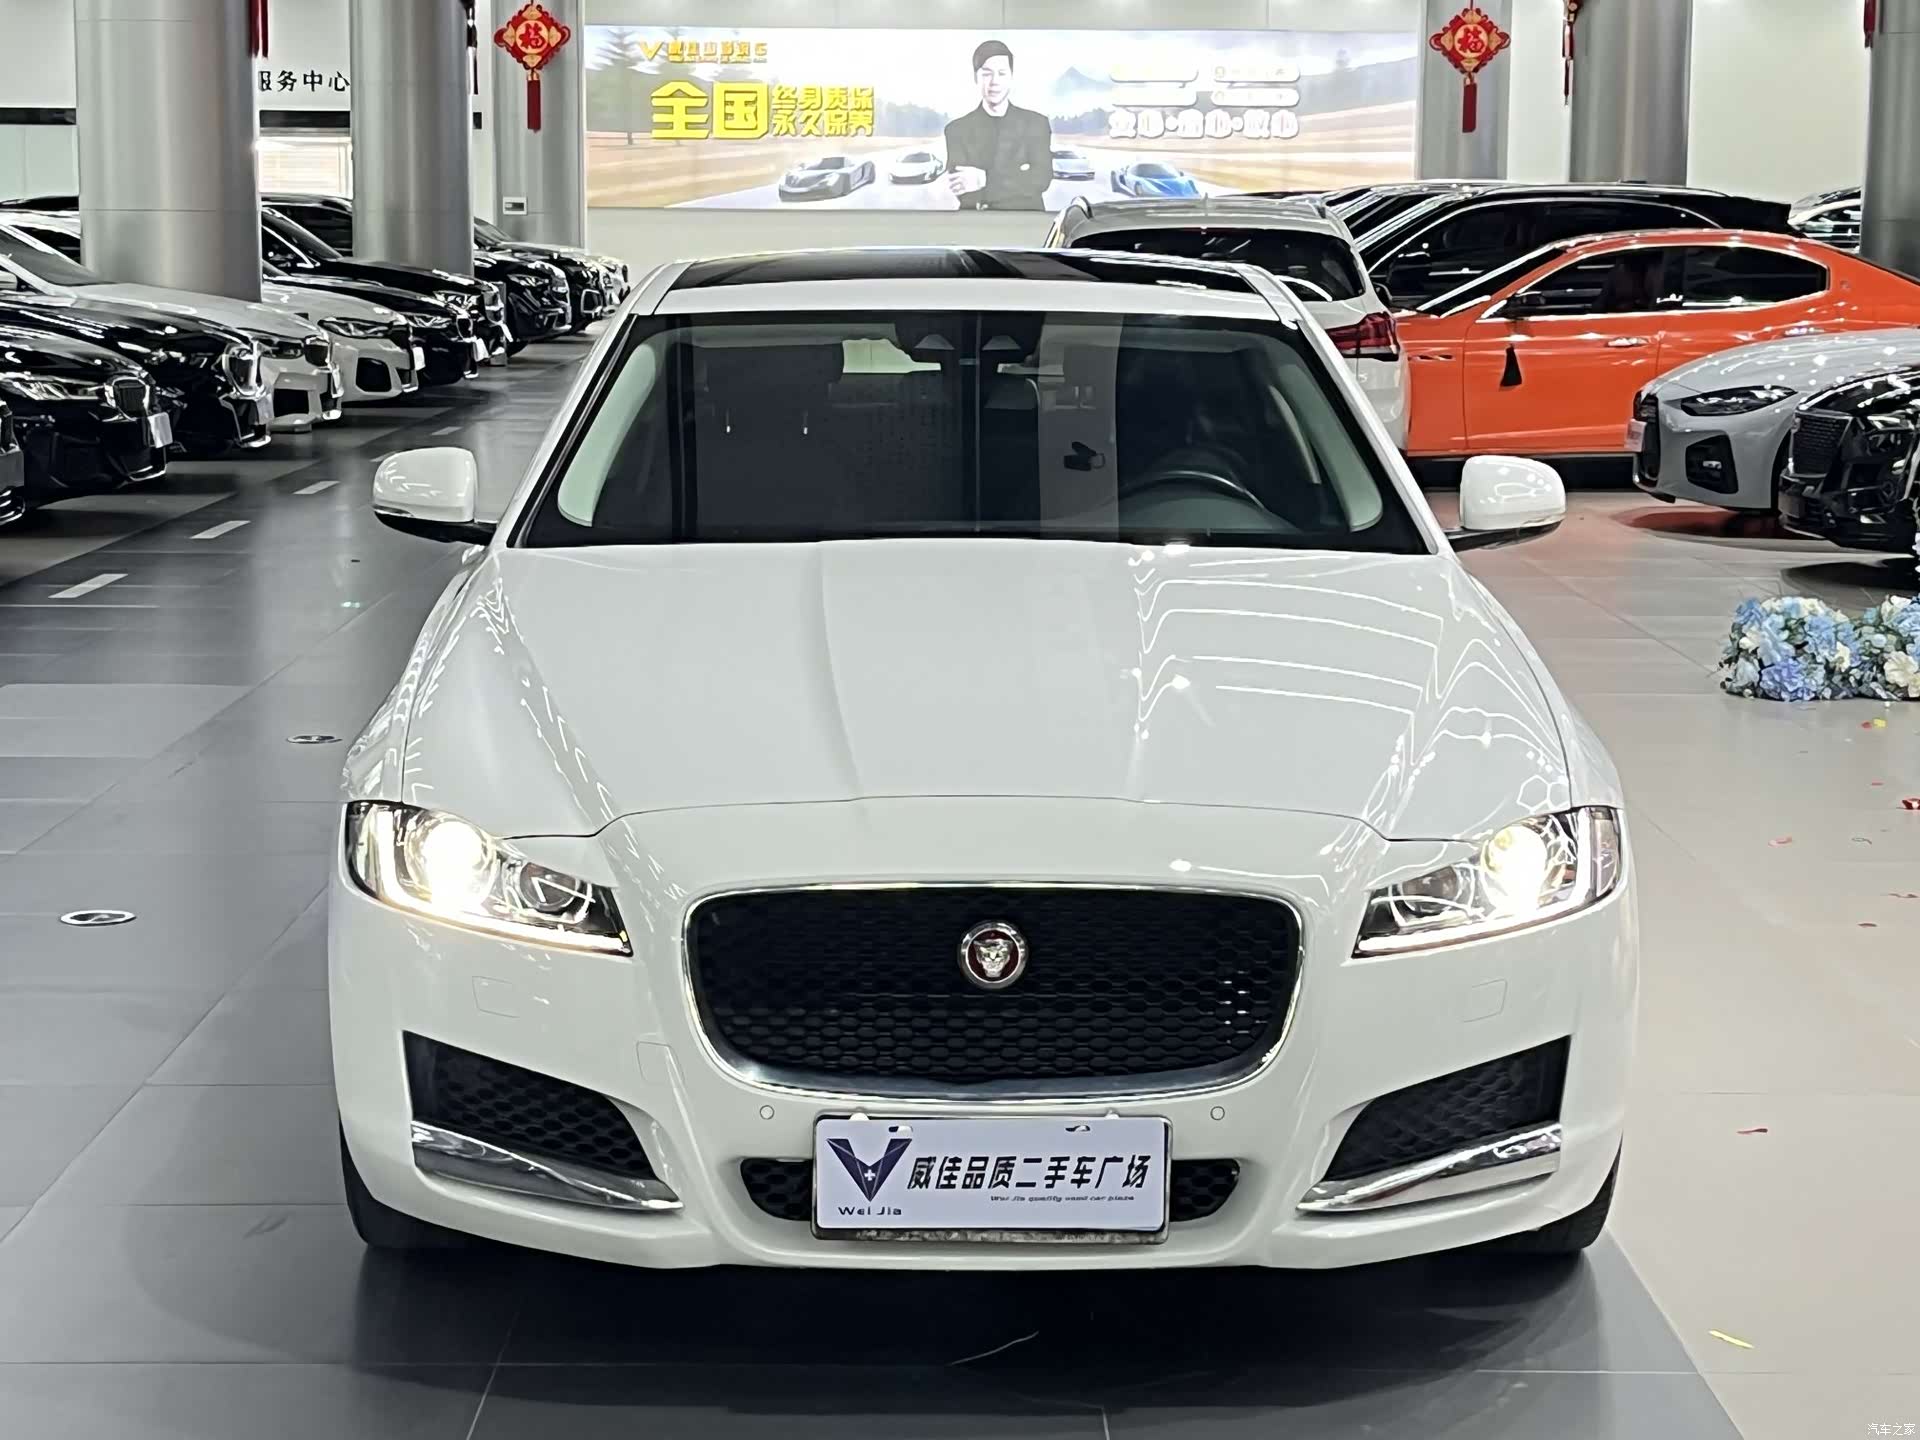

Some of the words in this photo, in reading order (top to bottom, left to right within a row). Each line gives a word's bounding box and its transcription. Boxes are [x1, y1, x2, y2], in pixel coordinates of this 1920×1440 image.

[519, 23, 546, 49] 福
[1458, 26, 1486, 53] 福
[651, 81, 769, 140] 全国
[771, 84, 874, 111] 终身质保
[772, 110, 874, 137] 永久保养
[907, 1155, 1151, 1190] 威佳品质二手车广场
[838, 1206, 871, 1216] Wei
[877, 1206, 902, 1216] Jia
